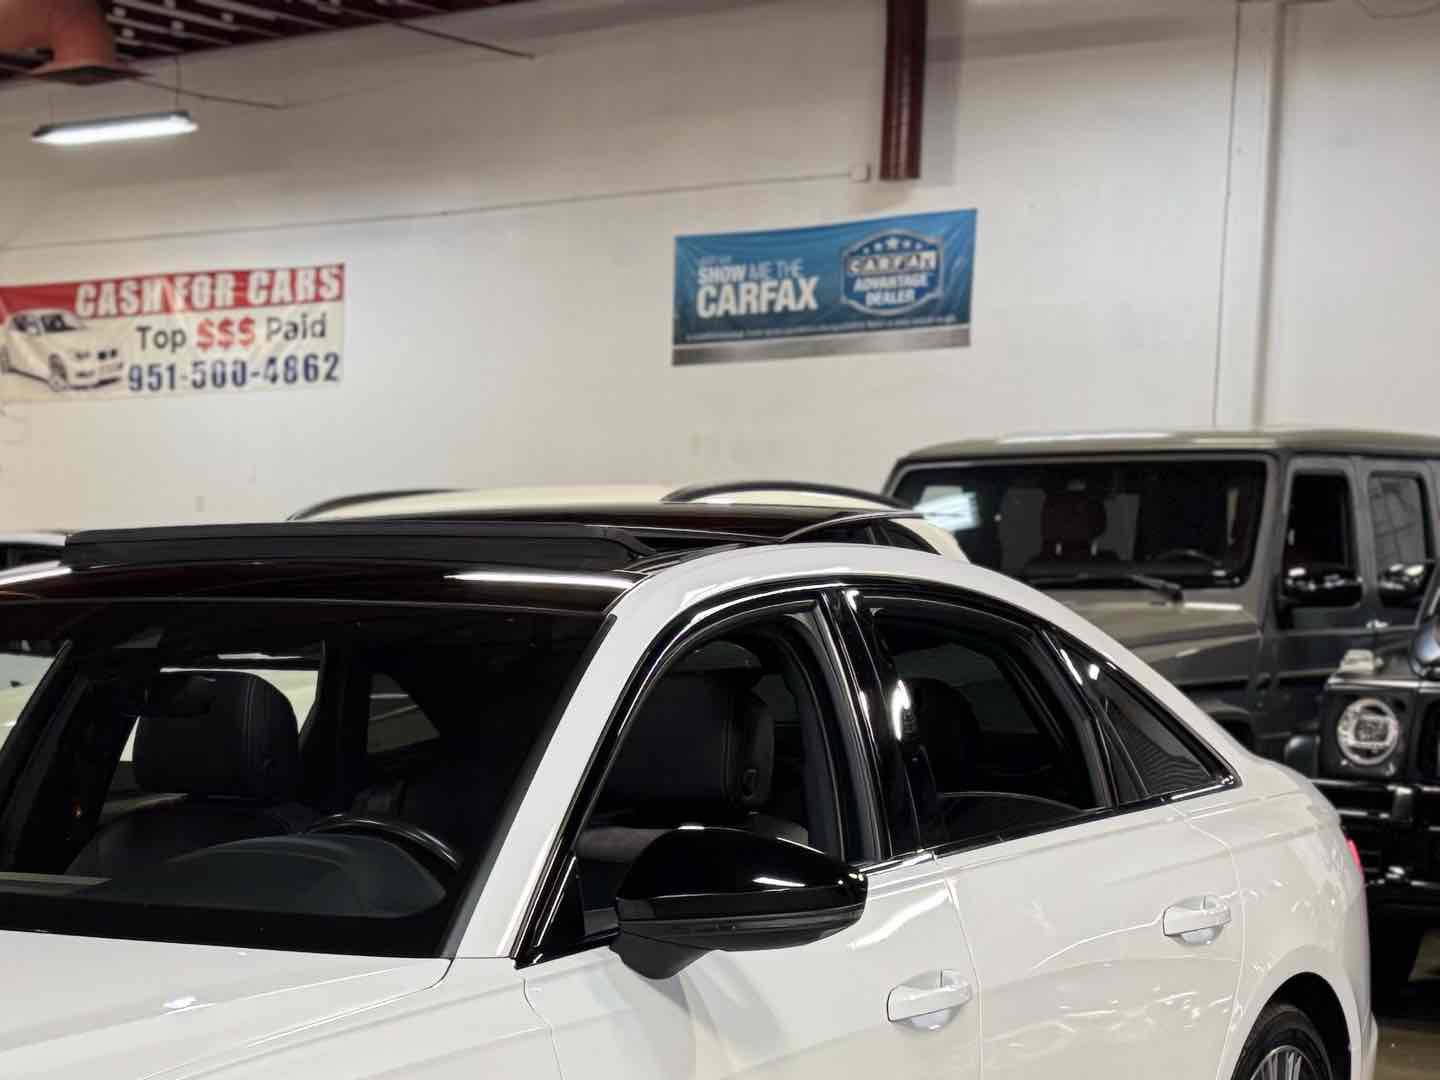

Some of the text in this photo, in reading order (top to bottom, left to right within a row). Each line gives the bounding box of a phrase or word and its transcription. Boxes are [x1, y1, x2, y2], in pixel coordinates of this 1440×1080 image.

[74, 266, 342, 318] CASH FOR CARS
[697, 258, 804, 285] SHOW ME THE
[696, 276, 819, 319] CARFAX
[137, 311, 328, 353] Top $$$ Paid
[128, 352, 340, 392] 951-500-4862
